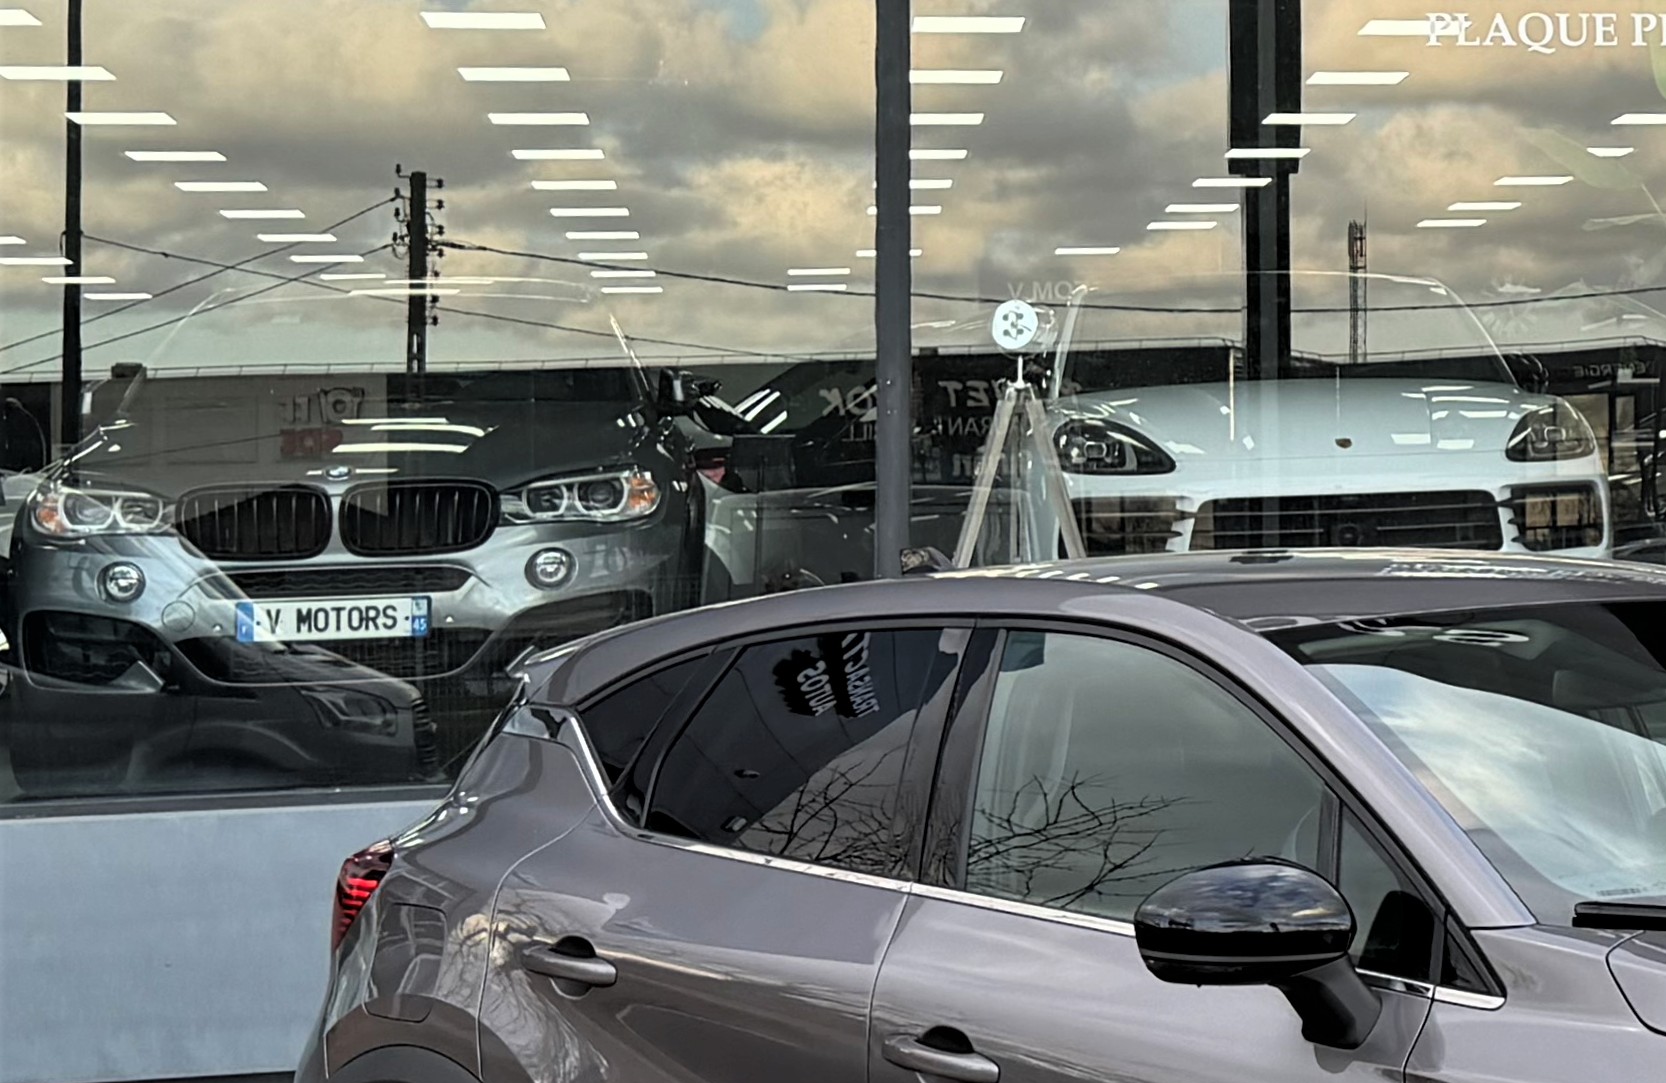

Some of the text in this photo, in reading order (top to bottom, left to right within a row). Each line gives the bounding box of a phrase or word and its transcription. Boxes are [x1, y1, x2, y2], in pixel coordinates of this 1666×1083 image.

[1425, 12, 1618, 54] PLAQUE
[266, 608, 281, 634] V
[296, 604, 398, 634] MOTORS
[412, 617, 427, 632] 45
